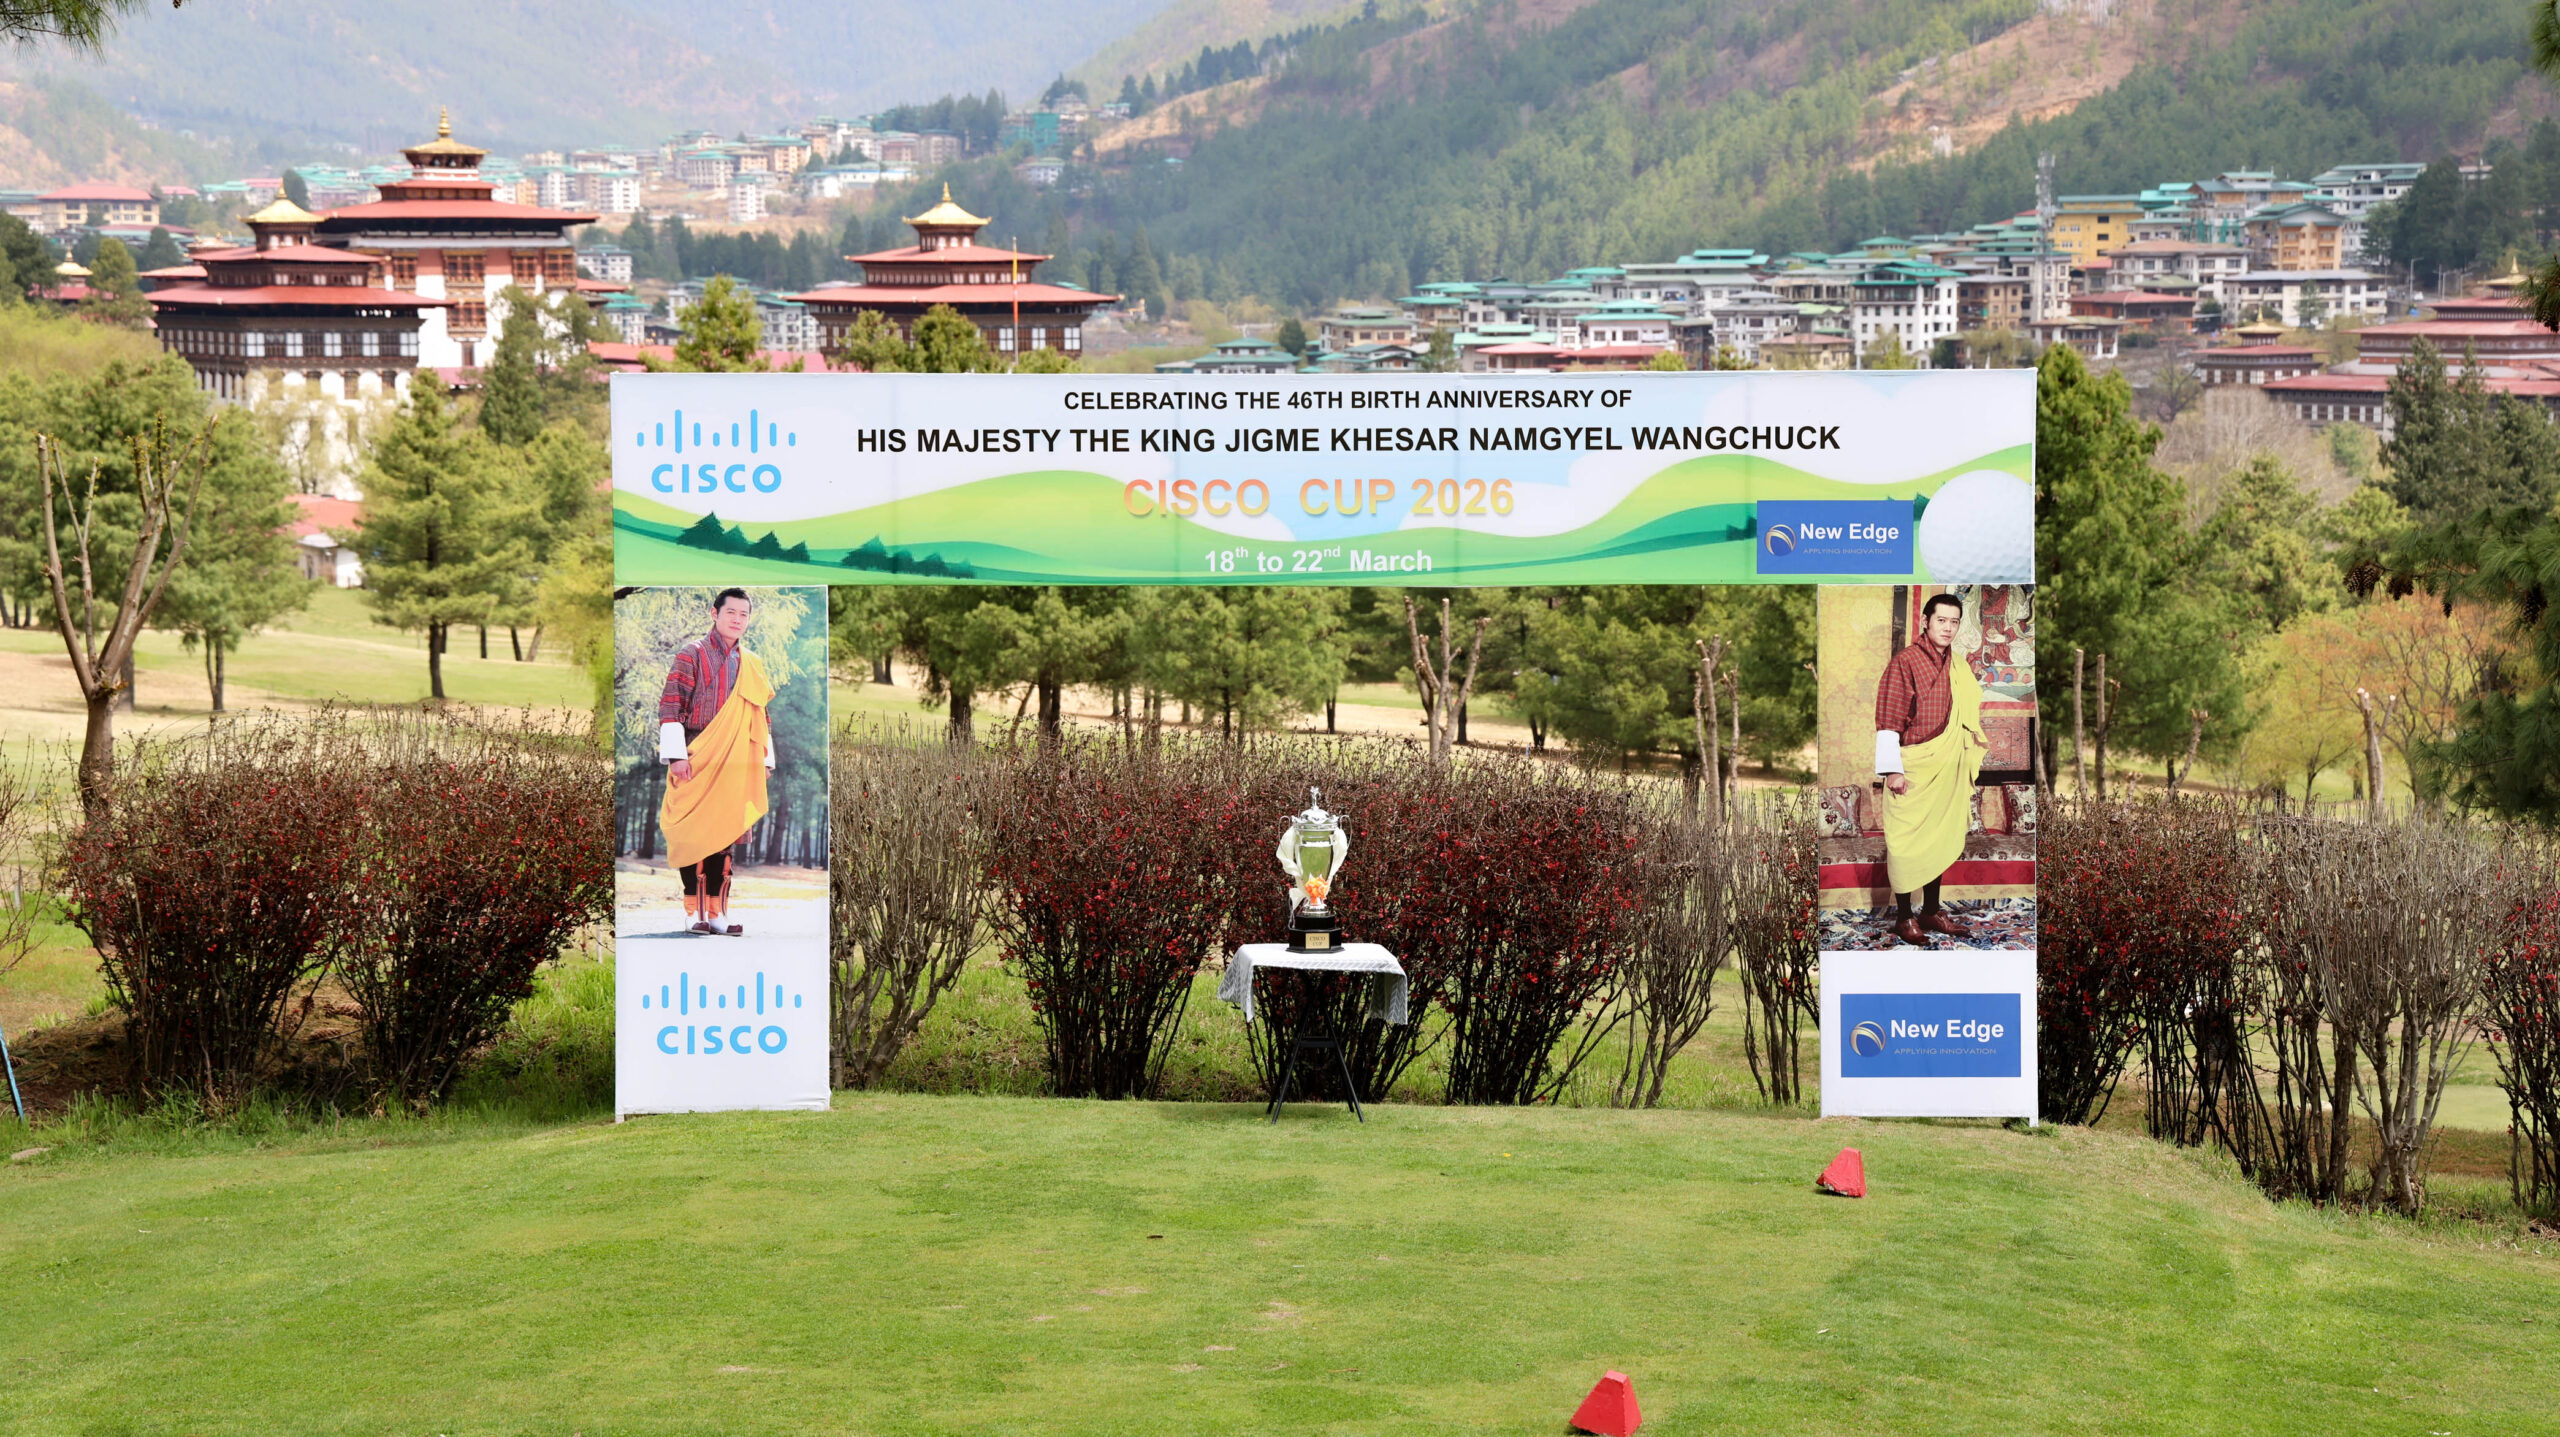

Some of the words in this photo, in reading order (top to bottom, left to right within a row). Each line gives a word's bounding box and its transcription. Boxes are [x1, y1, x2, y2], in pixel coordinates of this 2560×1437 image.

[1064, 391, 1228, 410] CELEBRATING
[1234, 391, 1280, 410] THE
[1287, 391, 1343, 410] 46TH
[1351, 390, 1420, 409] BIRTH
[1426, 389, 1594, 409] ANNIVERSARY
[1600, 389, 1632, 408] OF
[857, 428, 907, 453] HIS
[917, 428, 1061, 453] MAJESTY
[1069, 429, 1130, 452] THE
[1141, 428, 1215, 453] KING
[1225, 428, 1320, 453] JIGME
[1331, 427, 1460, 452] KHESAR
[1469, 426, 1623, 451] NAMGYEL
[1631, 425, 1841, 450] WANGCHUCK
[651, 463, 782, 494] CISCO
[1124, 478, 1270, 517] CISCO
[1299, 478, 1396, 516] CUP
[1410, 477, 1515, 516] 2026
[1800, 523, 1843, 540] New
[1849, 523, 1900, 544] Edge
[1204, 547, 1249, 573] 18th
[1256, 551, 1284, 573] to
[1291, 546, 1342, 573] 22nd
[1350, 549, 1433, 573] March
[656, 1025, 788, 1055] CISCO
[1890, 1019, 1940, 1038] New
[1946, 1019, 2005, 1043] Edge
[1894, 1047, 1938, 1055] APPLYING
[1939, 1047, 1997, 1055] INNOVATION
